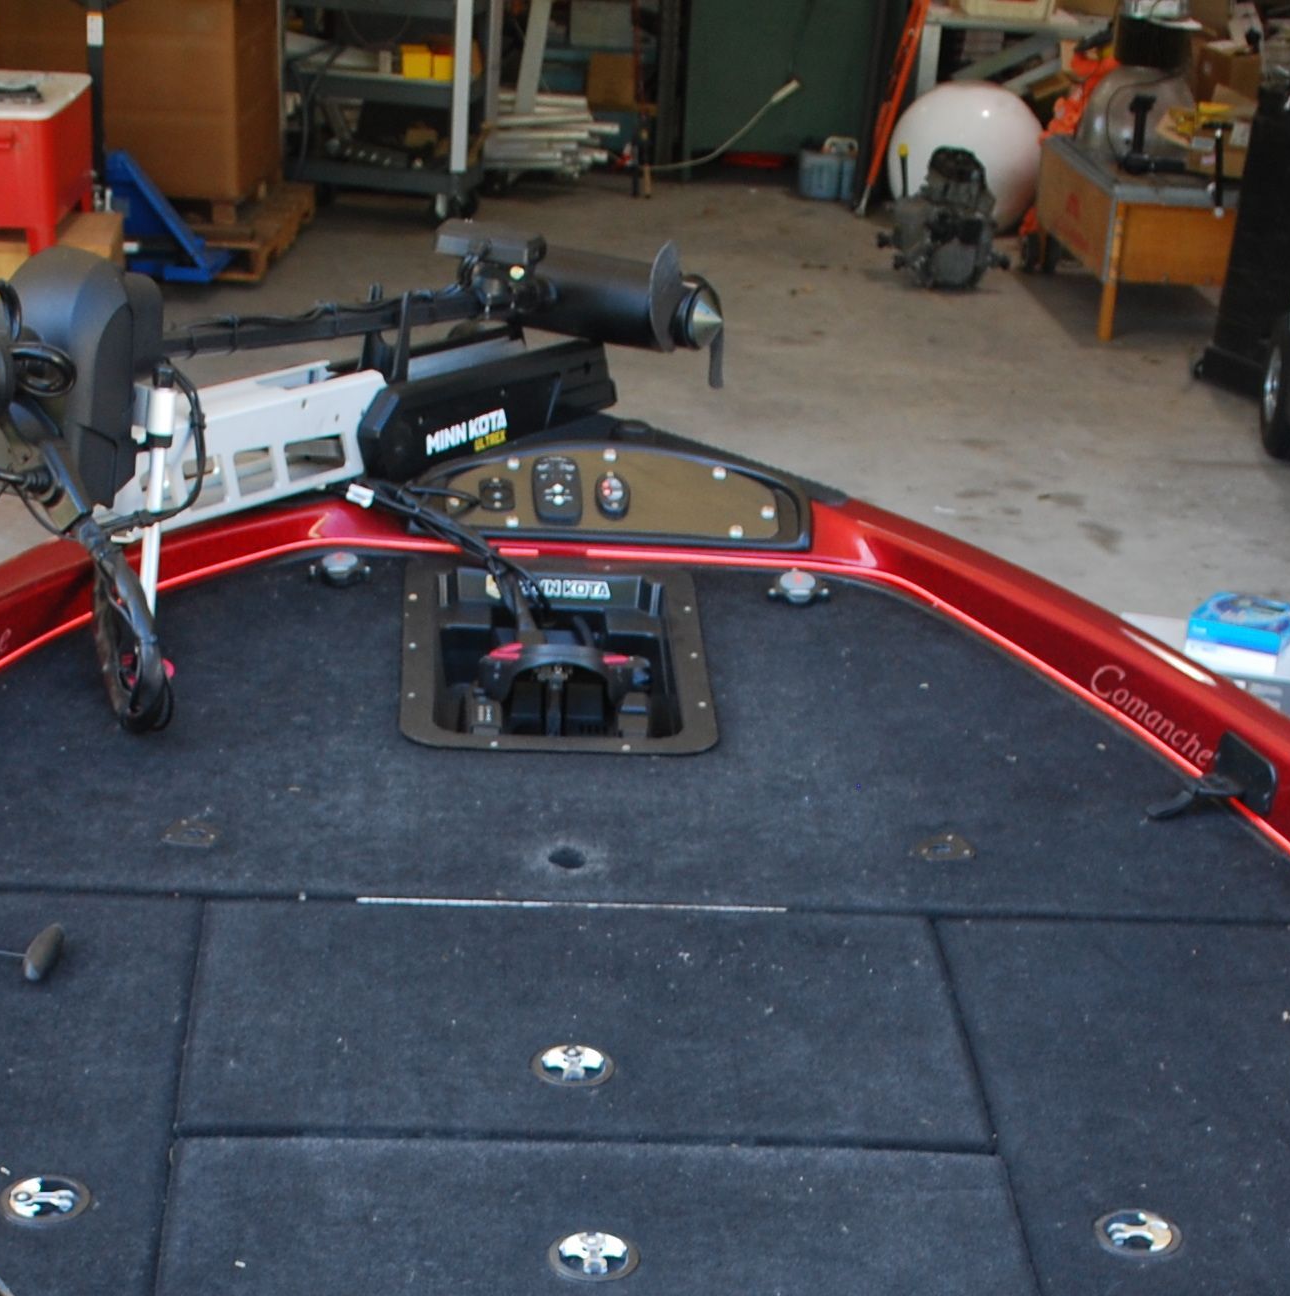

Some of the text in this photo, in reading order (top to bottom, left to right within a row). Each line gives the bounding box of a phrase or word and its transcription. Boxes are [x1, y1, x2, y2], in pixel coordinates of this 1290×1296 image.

[426, 407, 508, 456] MINN KOTA
[562, 579, 611, 600] KOTA
[1090, 664, 1214, 767] Comanche
